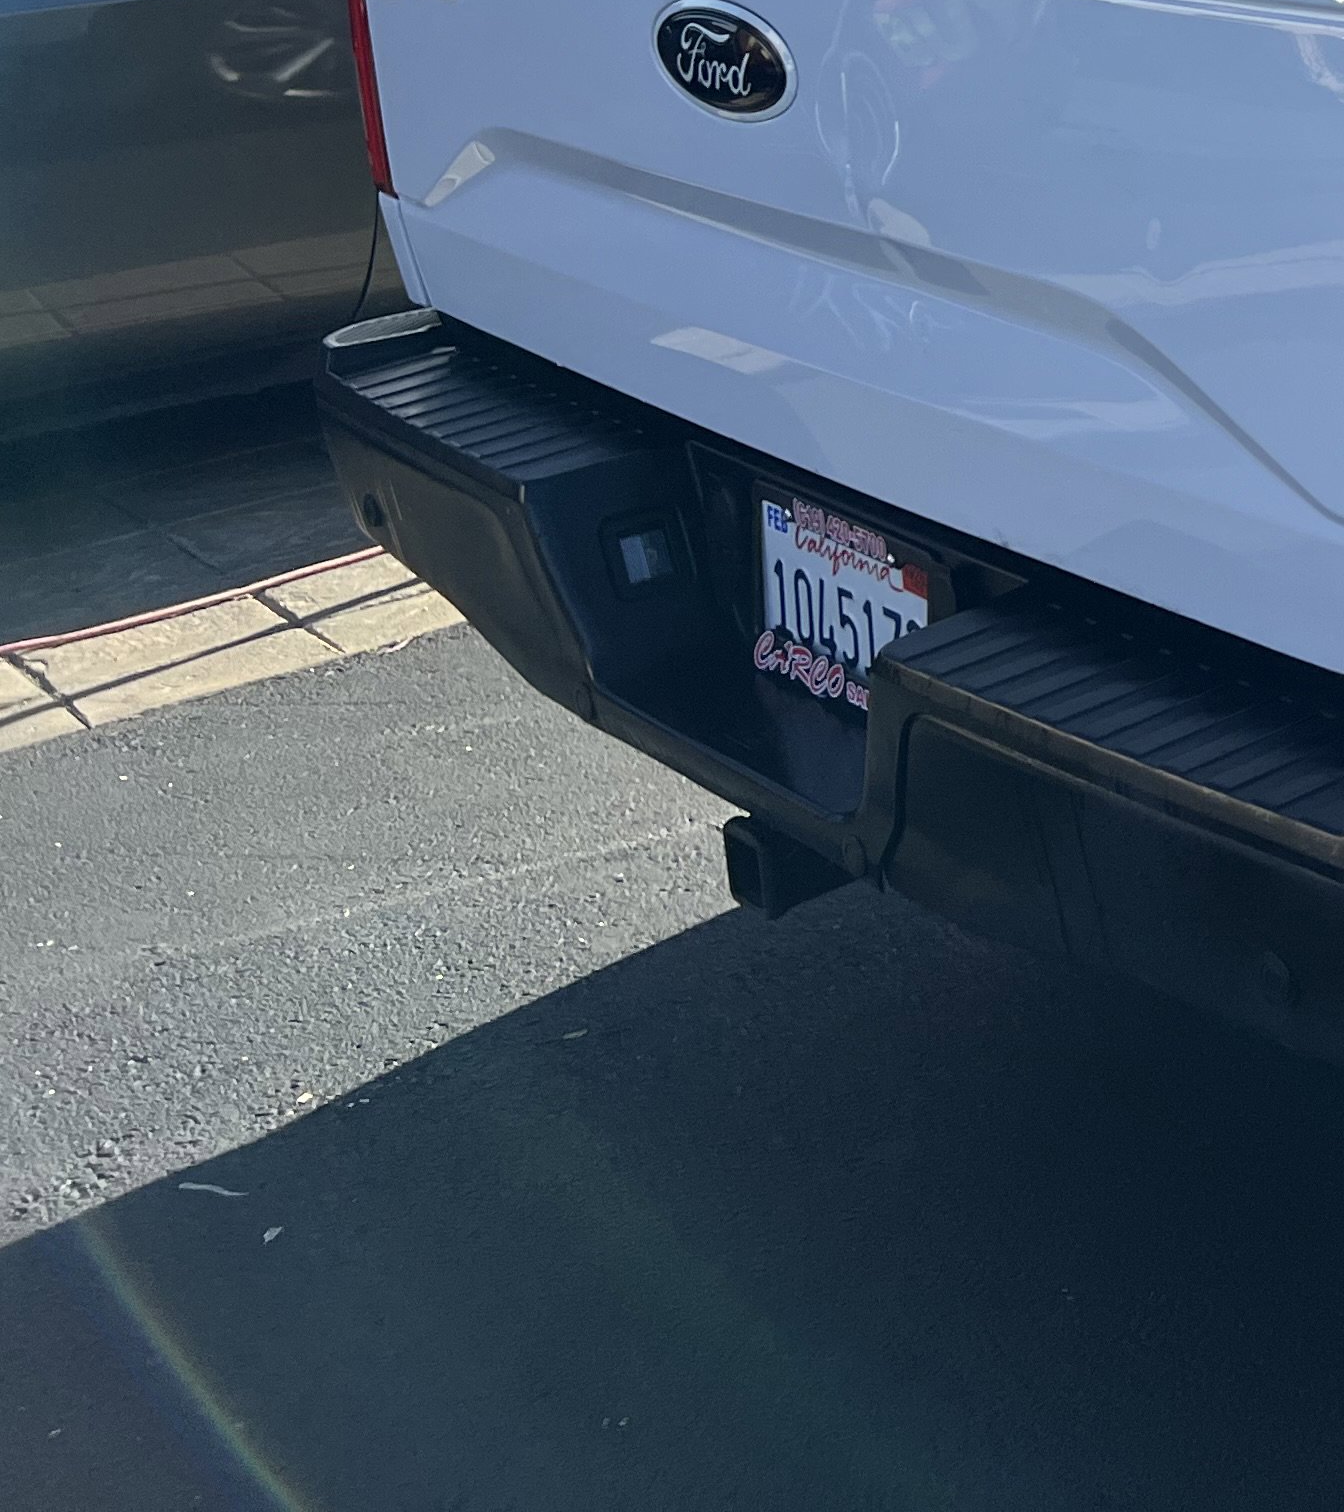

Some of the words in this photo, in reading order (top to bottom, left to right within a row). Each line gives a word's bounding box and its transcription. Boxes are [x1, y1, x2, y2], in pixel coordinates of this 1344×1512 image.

[676, 22, 752, 97] Ford
[795, 525, 904, 593] California
[753, 630, 845, 698] CARCO
